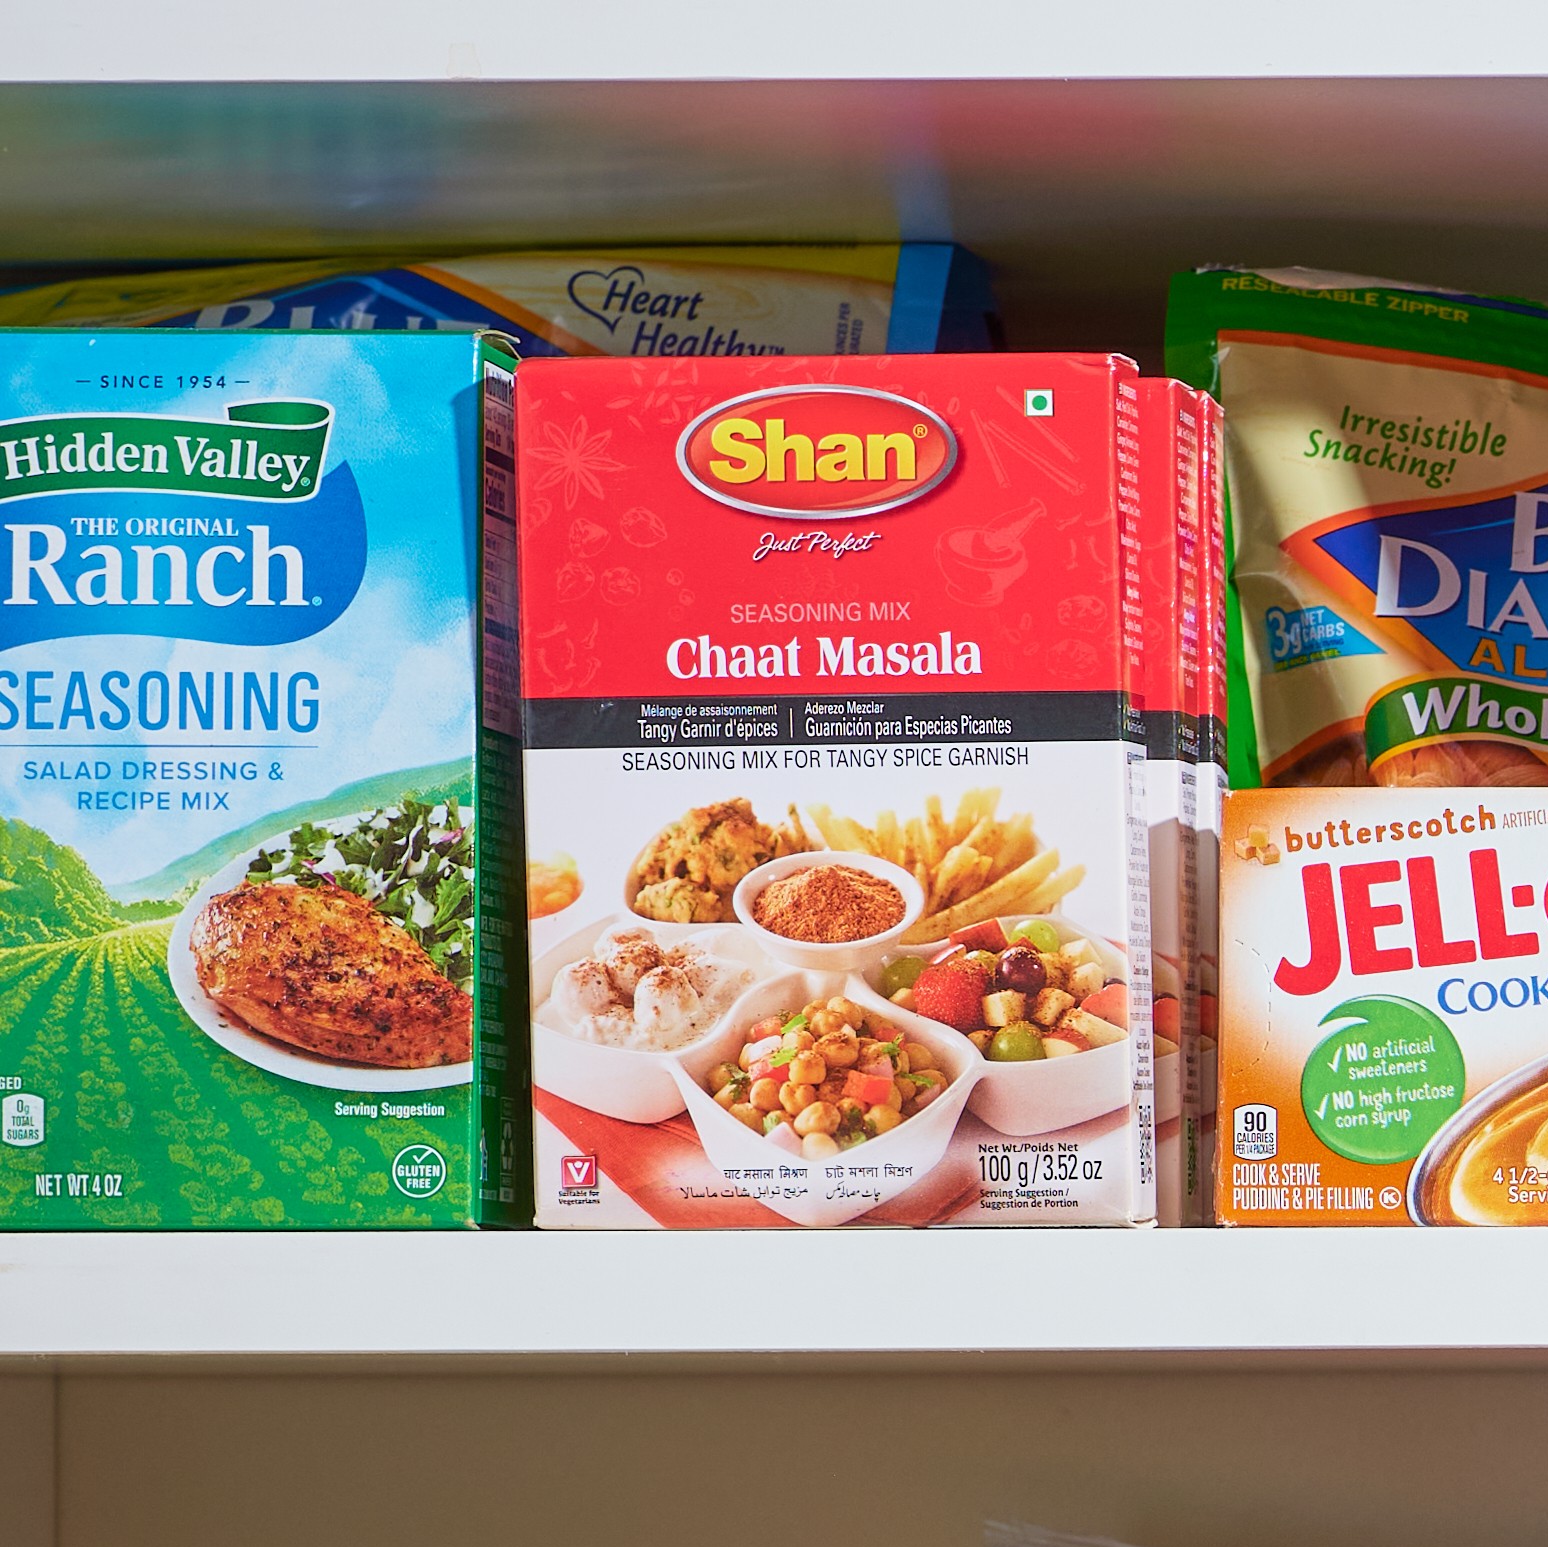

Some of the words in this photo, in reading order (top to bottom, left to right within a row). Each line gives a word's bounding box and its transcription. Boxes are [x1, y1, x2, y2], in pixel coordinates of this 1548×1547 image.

[100, 374, 165, 389] SINCE
[176, 374, 227, 389] 1954
[708, 418, 917, 483] Shan
[1339, 405, 1507, 457] Irresistible
[4, 431, 169, 482] Hidden
[174, 434, 310, 492] Valley
[1303, 428, 1457, 489] Snacking!
[4, 523, 310, 607] Ranch
[753, 533, 804, 562] Just
[807, 531, 881, 558] Perfect
[666, 634, 802, 679] Chaat
[816, 632, 983, 677] Masala
[0, 670, 320, 733] SEASONING
[804, 701, 843, 715] Aderezo
[846, 701, 884, 715] Mezclar
[1285, 805, 1496, 852] butterscotch
[1348, 1057, 1428, 1080] sweeteners
